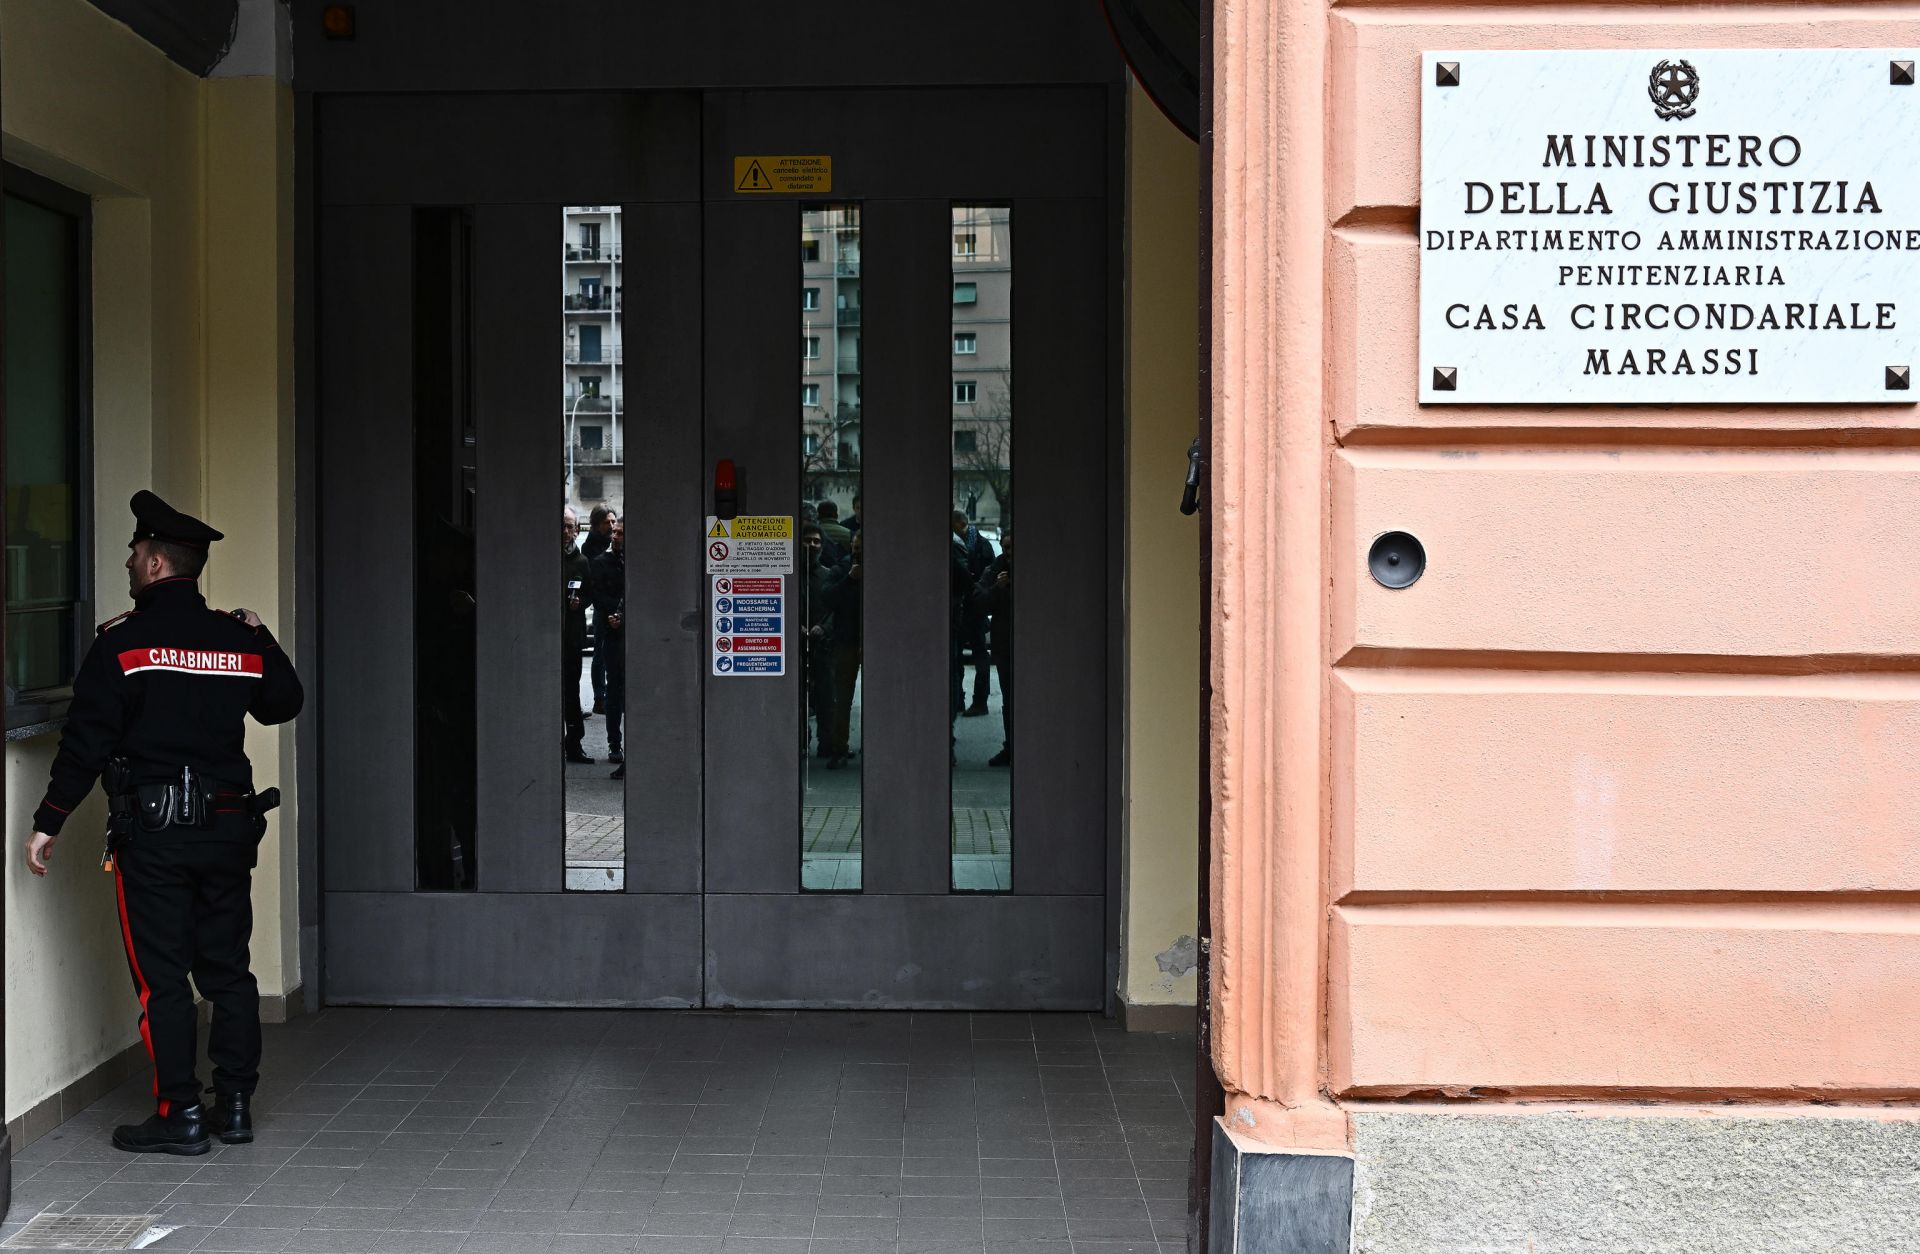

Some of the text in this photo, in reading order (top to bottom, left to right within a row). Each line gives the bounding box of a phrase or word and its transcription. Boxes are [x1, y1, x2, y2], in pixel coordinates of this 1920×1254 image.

[1542, 134, 1801, 168] MINISTERO
[1464, 181, 1883, 215] DELLA GIUSTIZIA
[1426, 229, 1920, 252] DIPARTIMENTO AMMINISTRAZIONE
[1558, 265, 1786, 286] PENITENZIARIA
[1445, 302, 1896, 330] CASA CIRCONDARIALE
[1583, 348, 1758, 376] MARASSI
[148, 648, 242, 671] CARABINIERI
